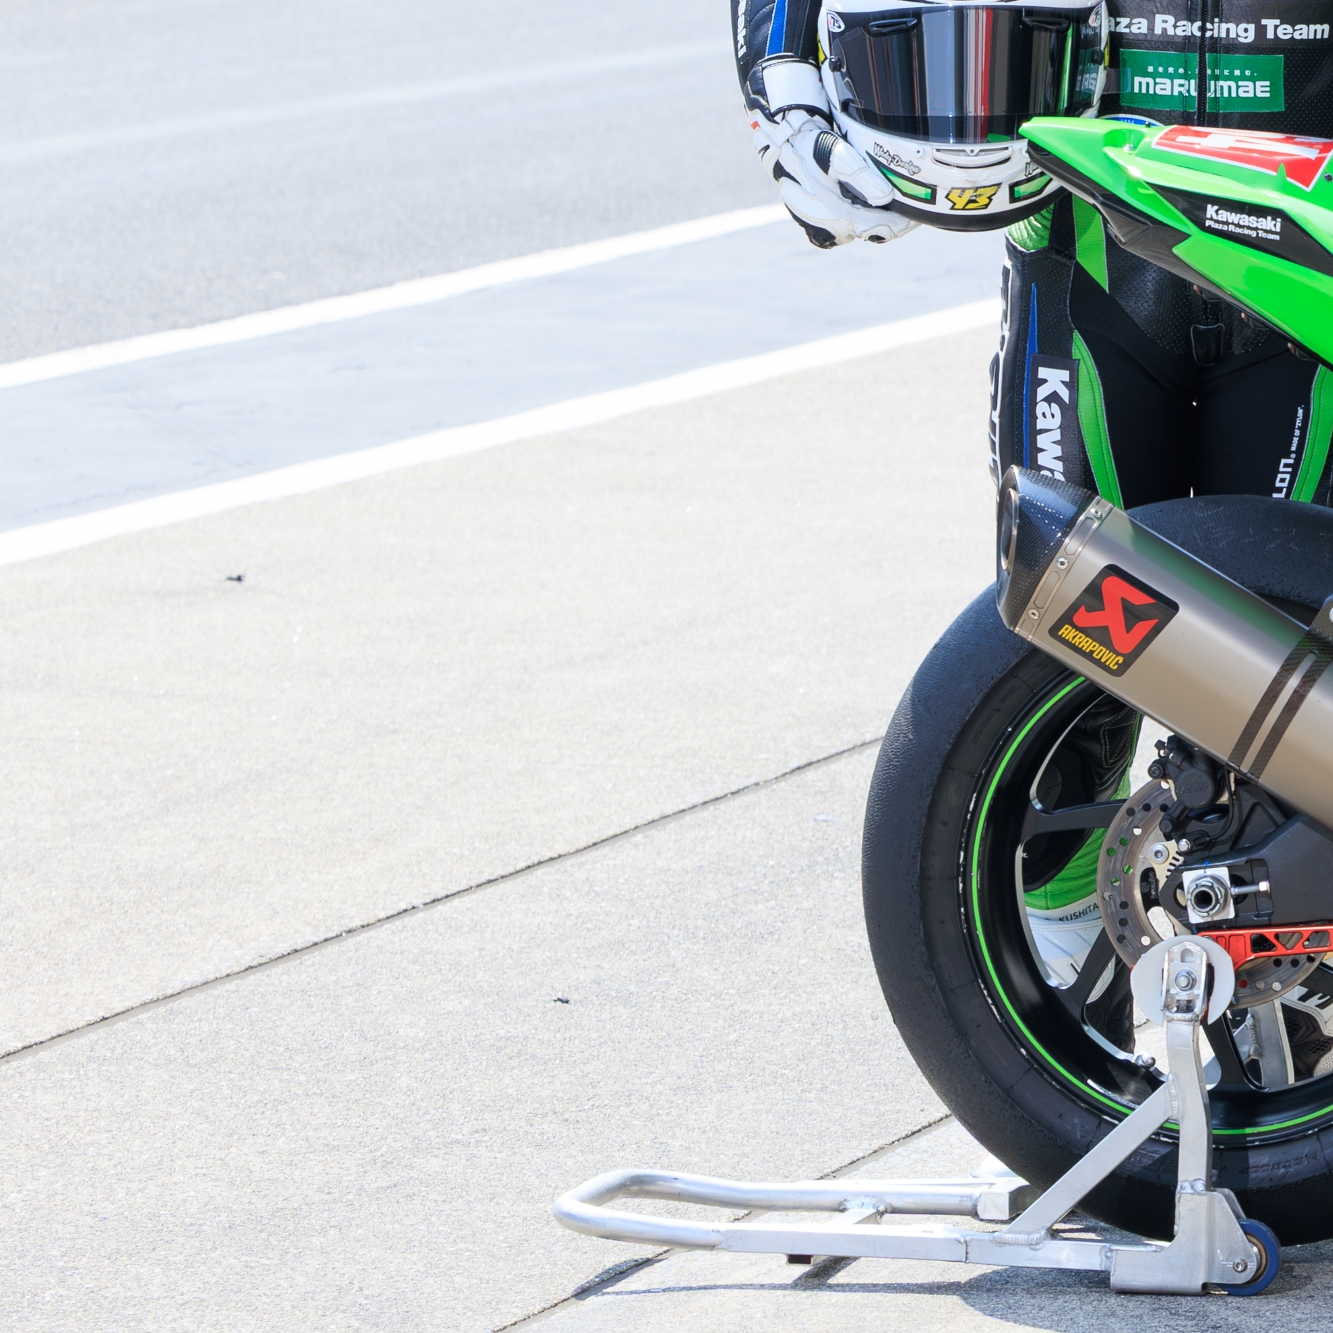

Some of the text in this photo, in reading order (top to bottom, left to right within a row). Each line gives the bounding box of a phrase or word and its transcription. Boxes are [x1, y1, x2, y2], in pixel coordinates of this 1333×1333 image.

[1108, 14, 1330, 43] aza Racing Team
[1205, 219, 1280, 241] Plaza Racing Team
[1206, 203, 1282, 233] Kawasaki
[1059, 902, 1100, 922] KUSHITA
